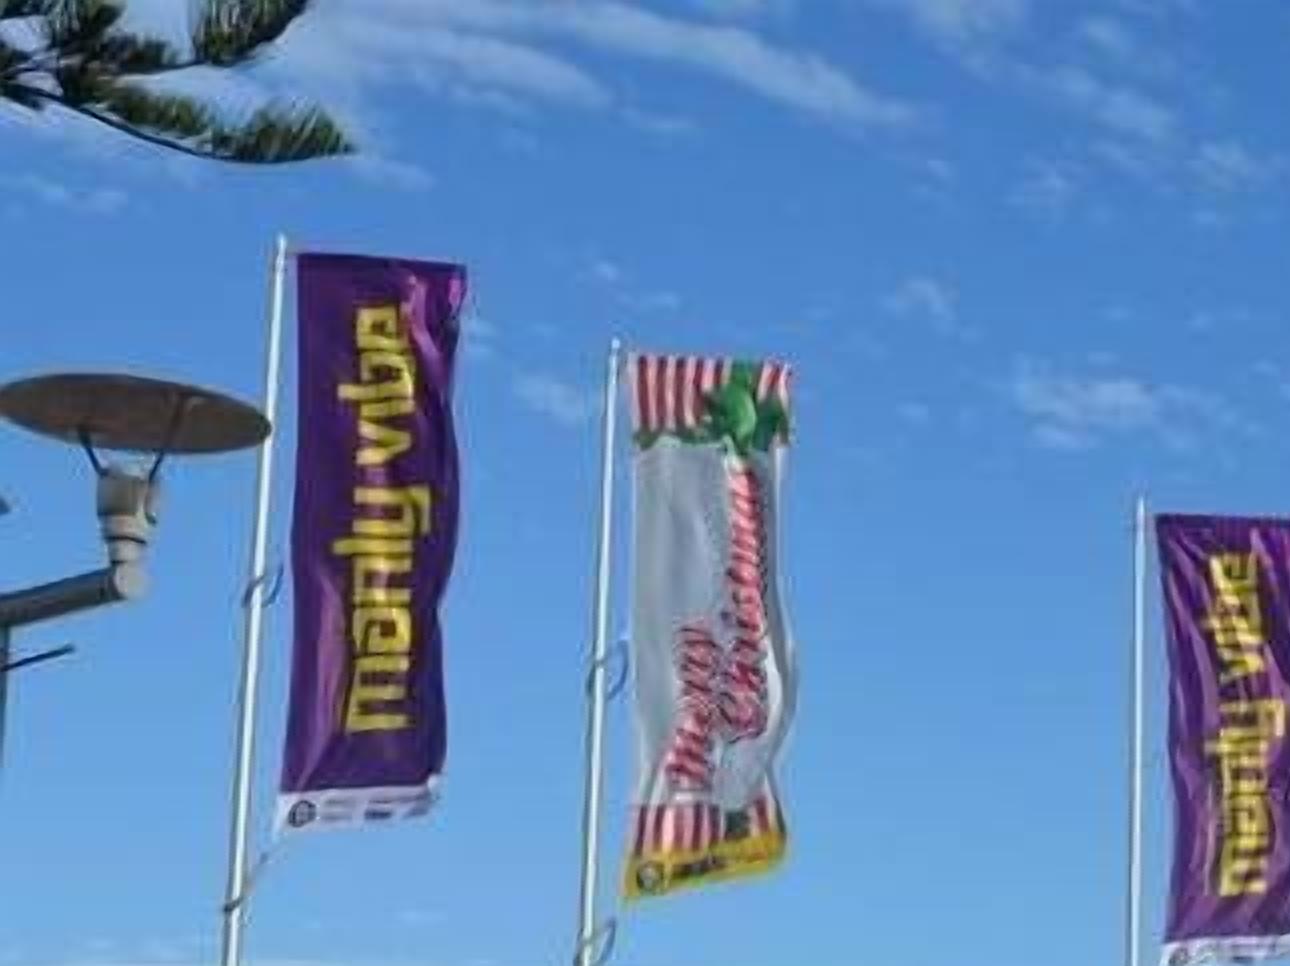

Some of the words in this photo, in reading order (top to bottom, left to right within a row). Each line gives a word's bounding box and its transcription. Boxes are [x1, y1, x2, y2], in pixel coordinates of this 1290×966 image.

[337, 305, 416, 465] vibe
[333, 486, 432, 733] manly
[1202, 555, 1262, 677] vibe
[1204, 700, 1286, 897] manly
